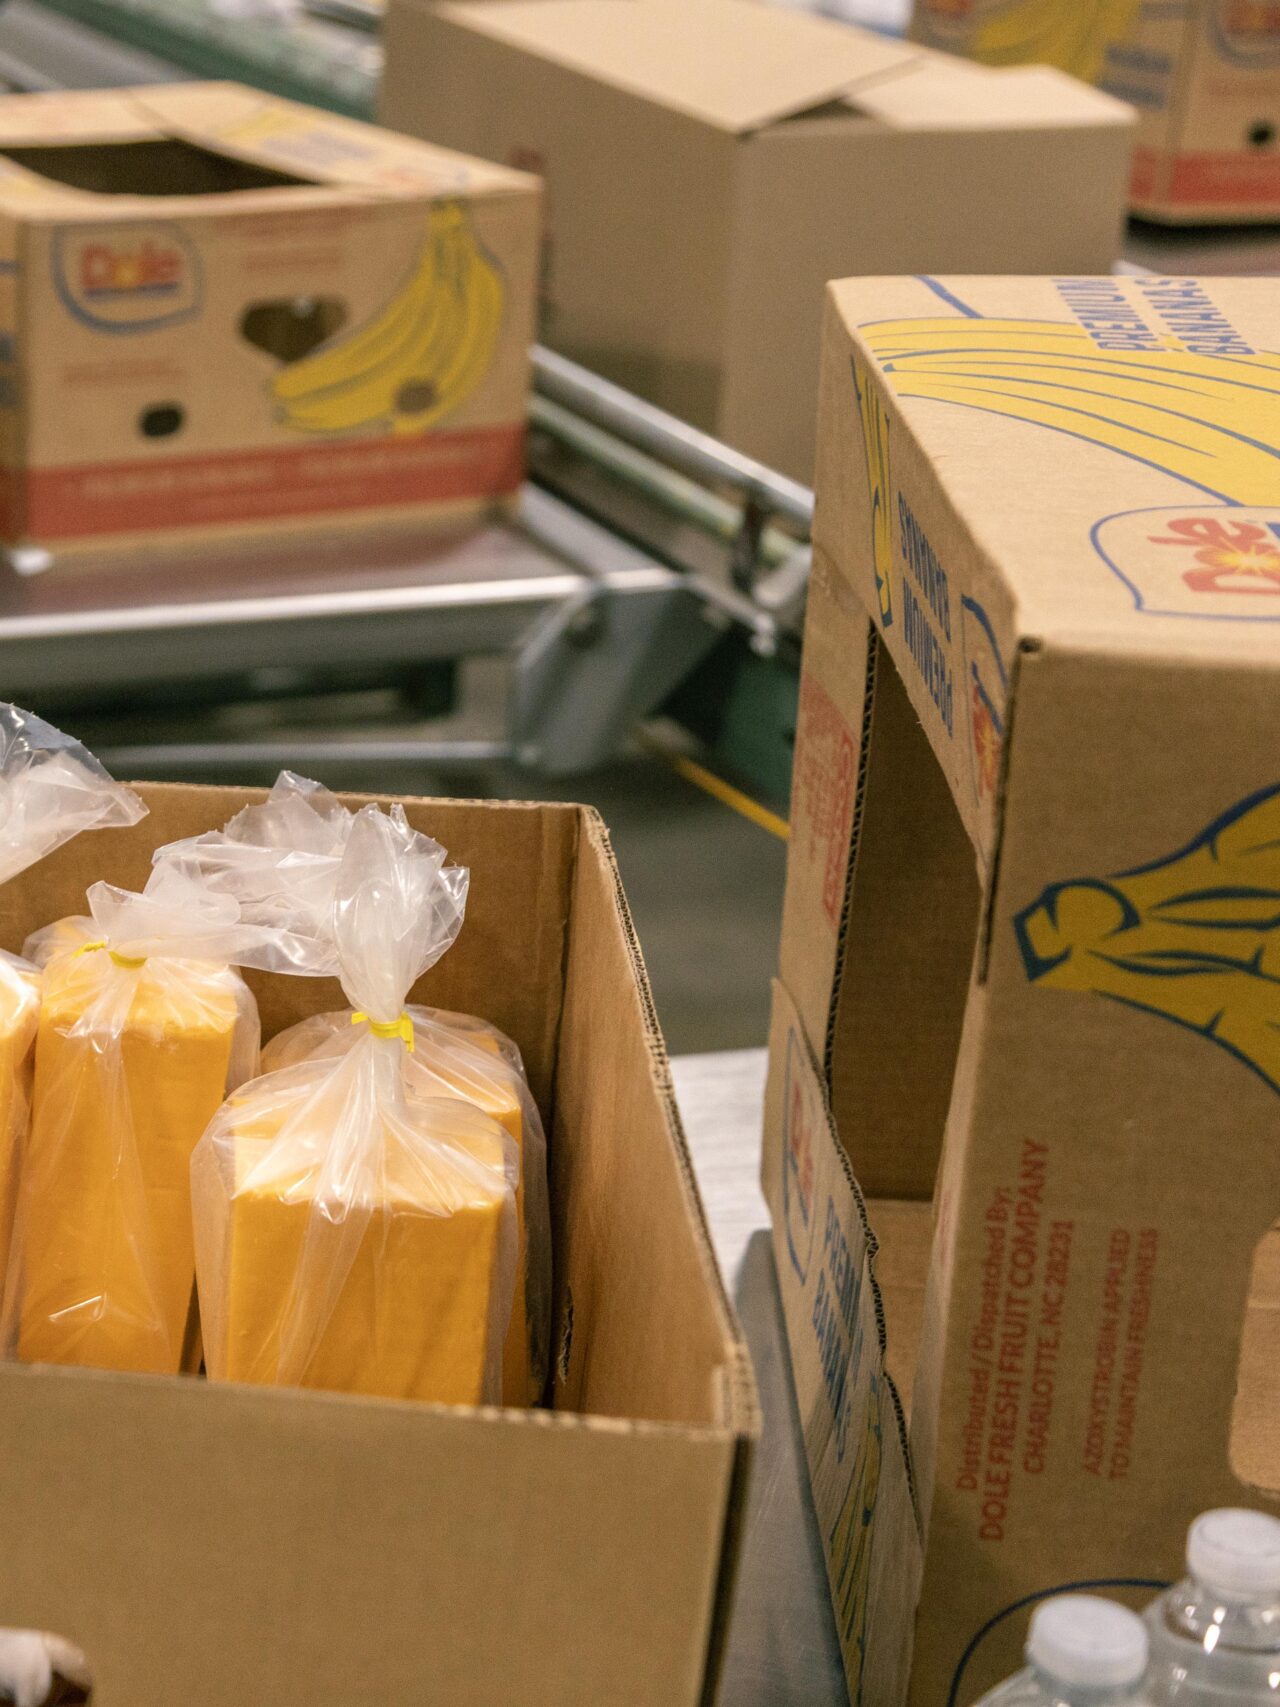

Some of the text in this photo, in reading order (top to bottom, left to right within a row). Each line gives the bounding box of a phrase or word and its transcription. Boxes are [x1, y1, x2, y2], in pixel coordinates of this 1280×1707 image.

[1052, 278, 1167, 352] PREMIUM
[1134, 279, 1256, 355] BANANAS
[972, 1226, 1006, 1349] Dispatched
[1104, 1229, 1130, 1312] APPLIED
[979, 1137, 1049, 1541] DOLE FRESH FRUIT COMPANY
[1023, 1220, 1073, 1473] CHARLOTTE, NC 28231
[956, 1369, 990, 1490] Distributed
[1109, 1452, 1128, 1480] TO
